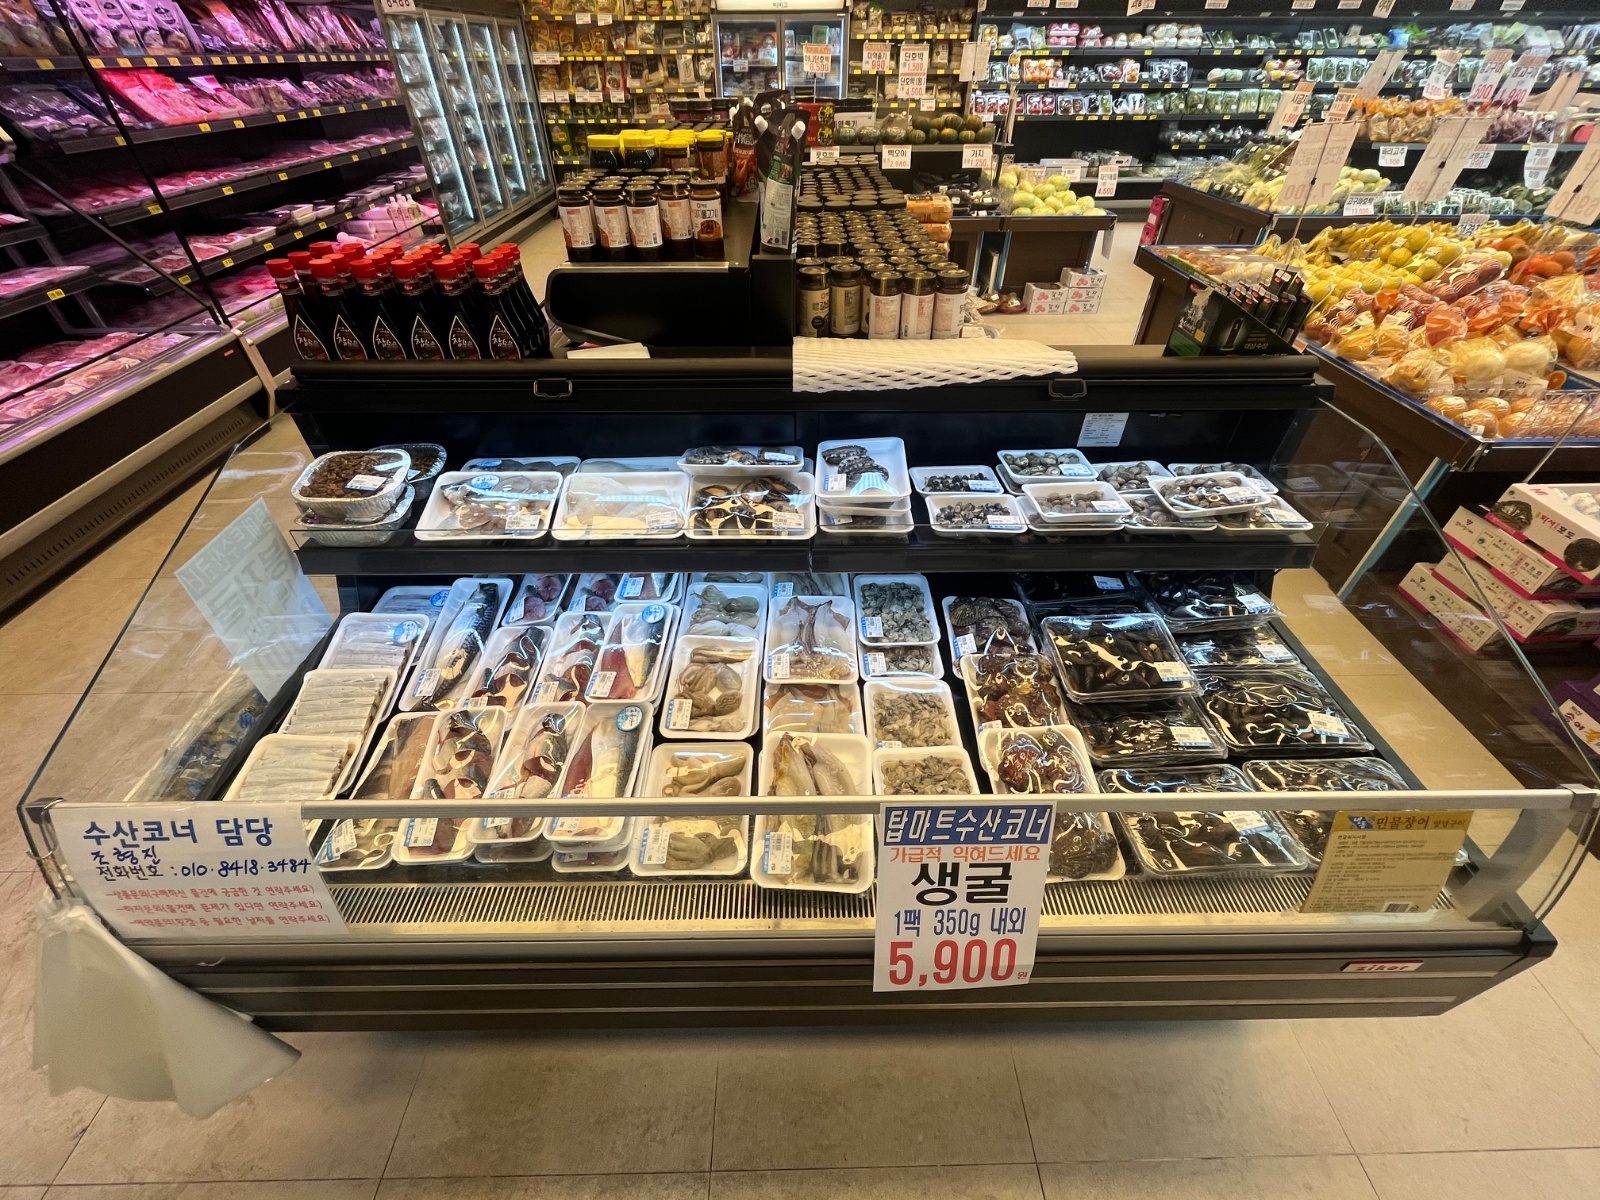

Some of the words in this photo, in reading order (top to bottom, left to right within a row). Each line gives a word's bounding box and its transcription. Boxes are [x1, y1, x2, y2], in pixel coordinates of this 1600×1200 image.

[871, 60, 887, 70] 990
[904, 52, 925, 62] 단호박
[809, 63, 830, 72] 8,500
[970, 149, 984, 158] 가지
[885, 807, 1051, 843] 탑마트수산코너
[1376, 814, 1431, 830] 민물장어
[83, 819, 199, 849] 수산코너
[215, 817, 274, 847] 담당
[890, 847, 942, 863] 가급적
[952, 845, 1041, 862] 익혀드세요
[96, 864, 164, 881] 전화번호
[221, 886, 249, 897] 궁금한
[251, 886, 262, 896] 것
[911, 862, 1012, 906] 생굴
[200, 901, 230, 912] 문제가
[235, 901, 265, 911] 있다면
[894, 908, 921, 937] 1팩
[933, 908, 981, 937] 350g
[990, 907, 1027, 935] 내외
[889, 938, 1017, 987] 5,900
